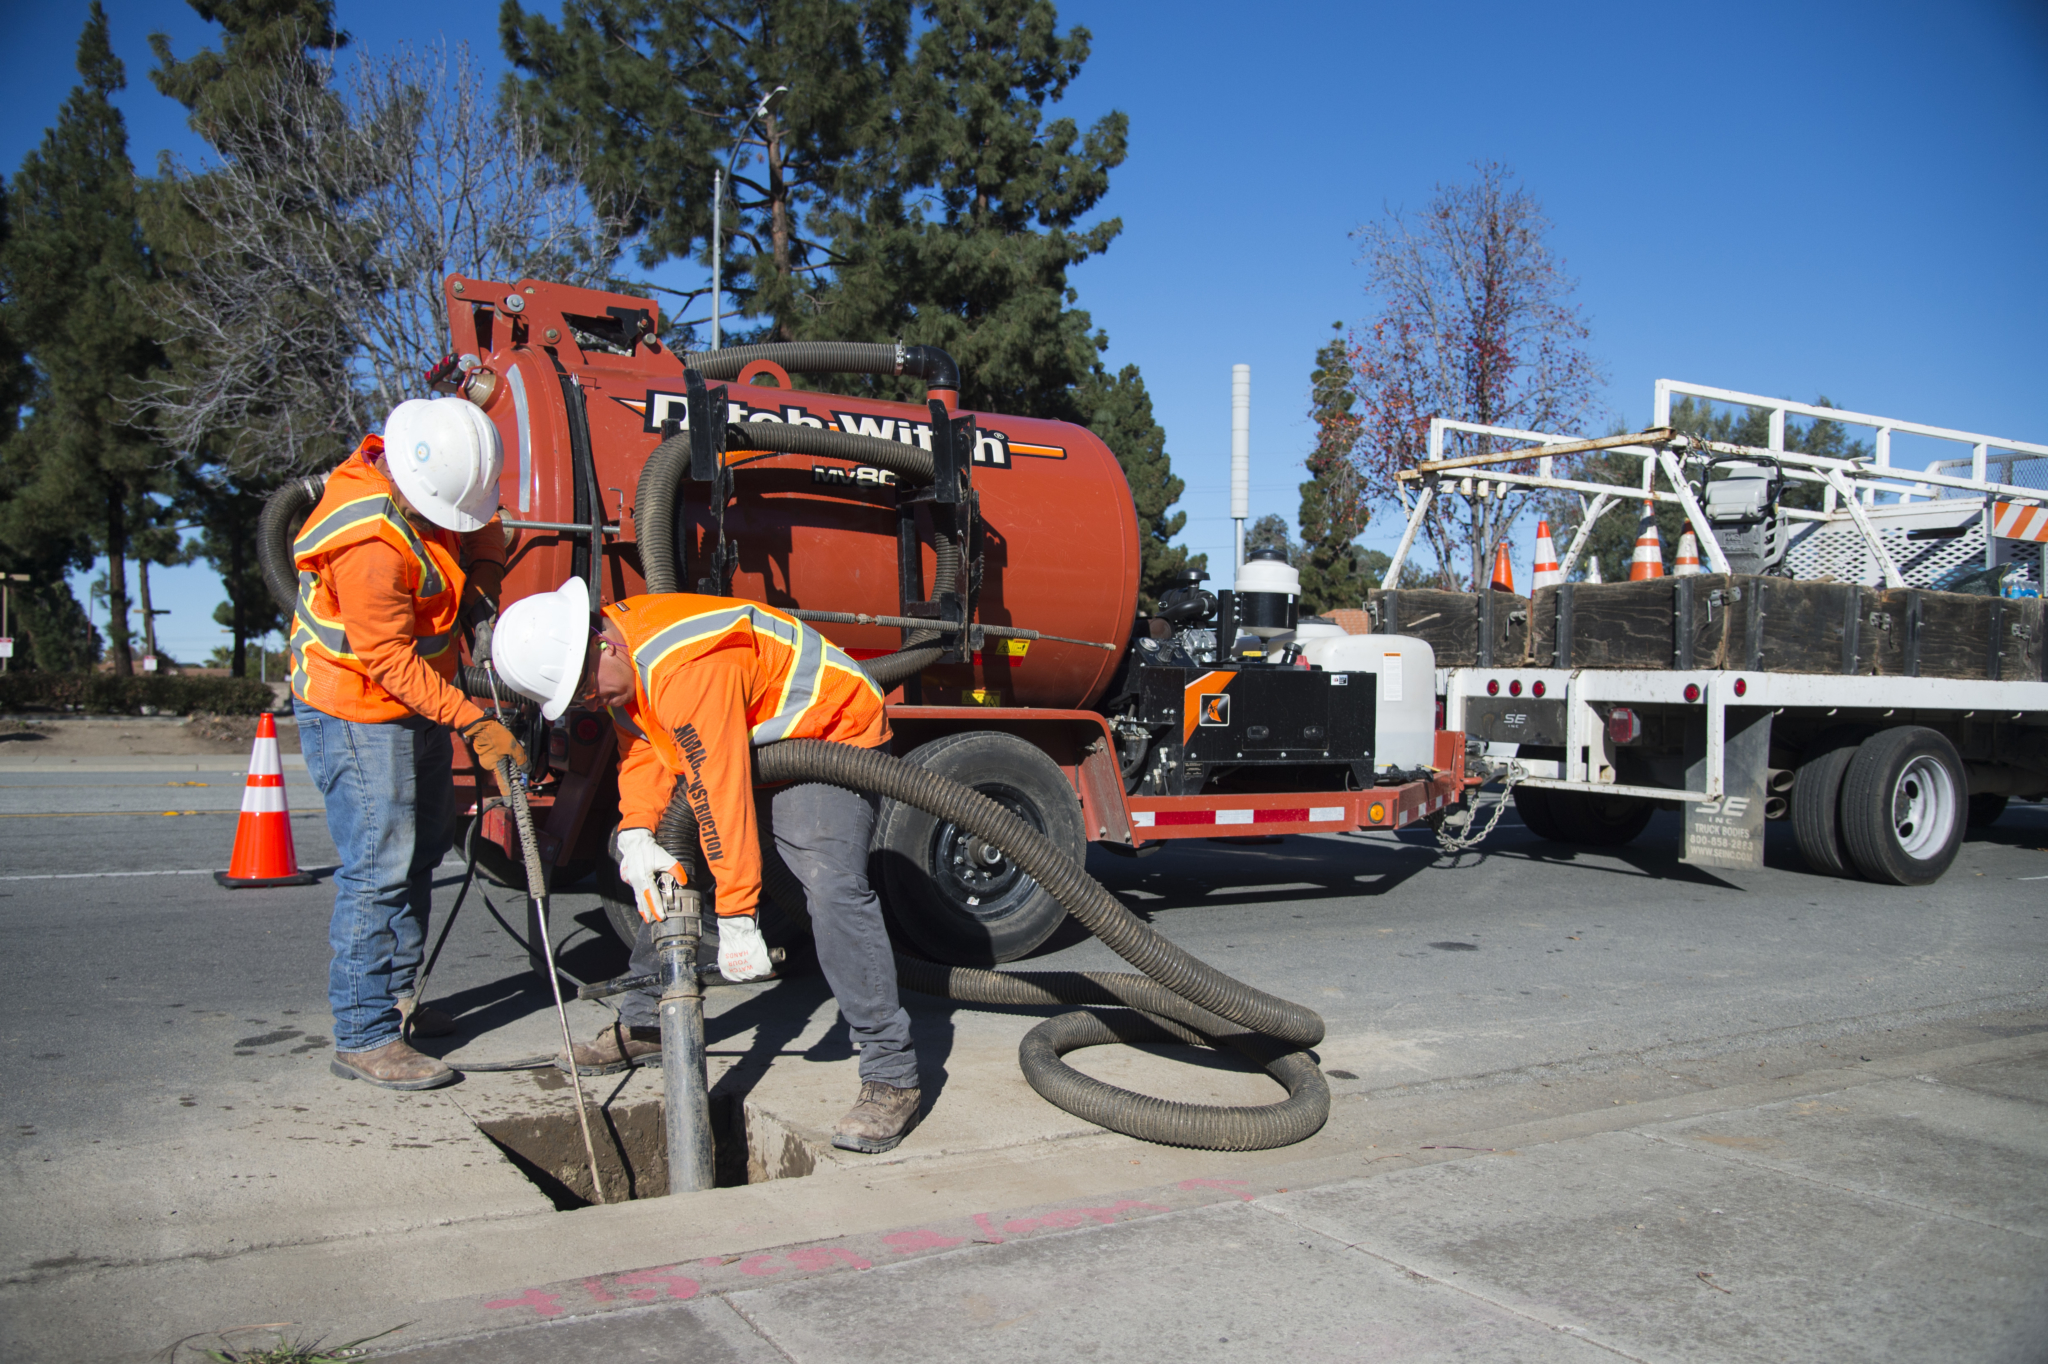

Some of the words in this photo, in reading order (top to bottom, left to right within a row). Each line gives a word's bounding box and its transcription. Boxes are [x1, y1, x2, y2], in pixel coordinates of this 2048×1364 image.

[839, 414, 1005, 464] With
[1503, 713, 1527, 724] SE
[1694, 796, 1751, 817] SE
[1695, 823, 1720, 835] TRUCK
[1722, 826, 1750, 839] BODIES
[725, 950, 749, 959] HANDS
[728, 958, 748, 967] YOUR
[729, 964, 753, 973] WATCH
